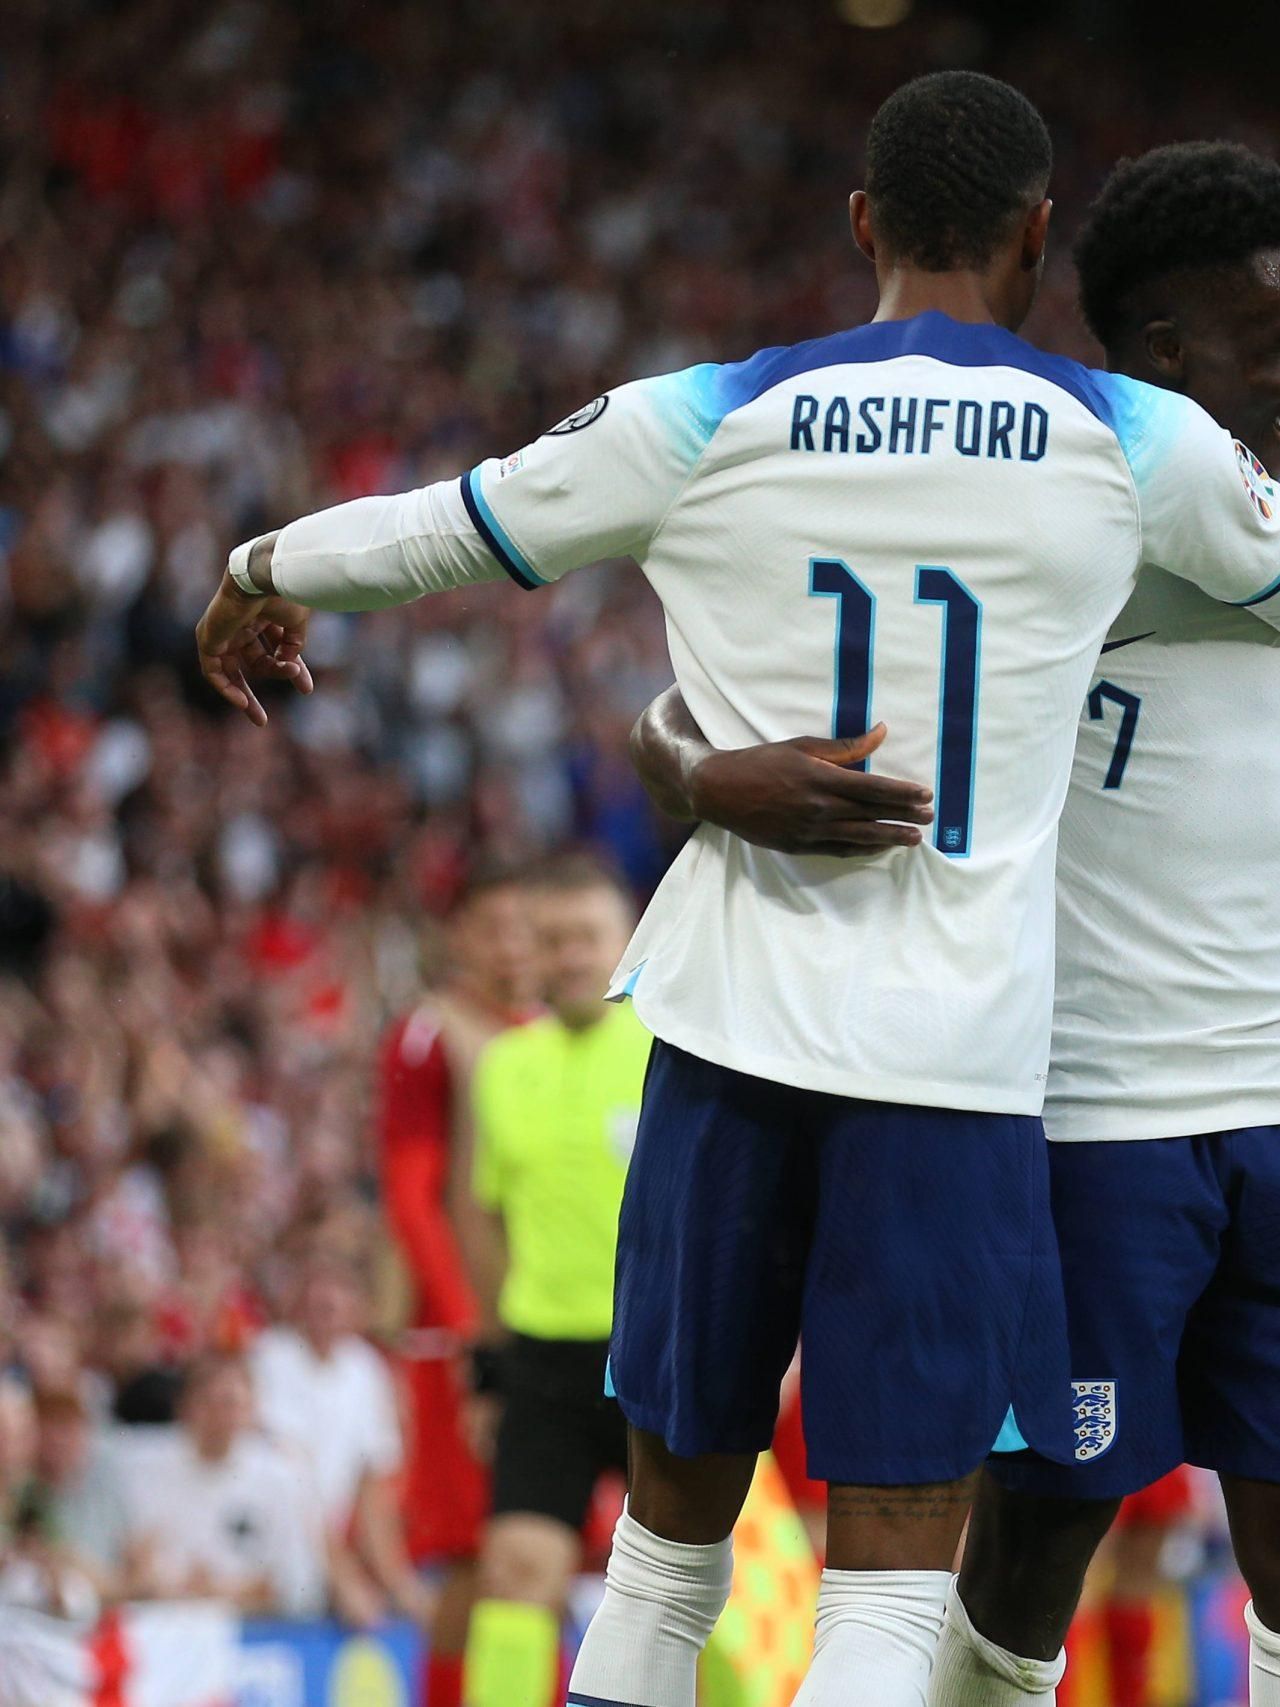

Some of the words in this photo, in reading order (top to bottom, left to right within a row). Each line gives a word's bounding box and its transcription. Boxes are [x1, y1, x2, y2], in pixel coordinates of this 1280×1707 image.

[789, 394, 1049, 462] RASHFORD
[807, 557, 984, 859] 11
[1087, 679, 1142, 790] 7
